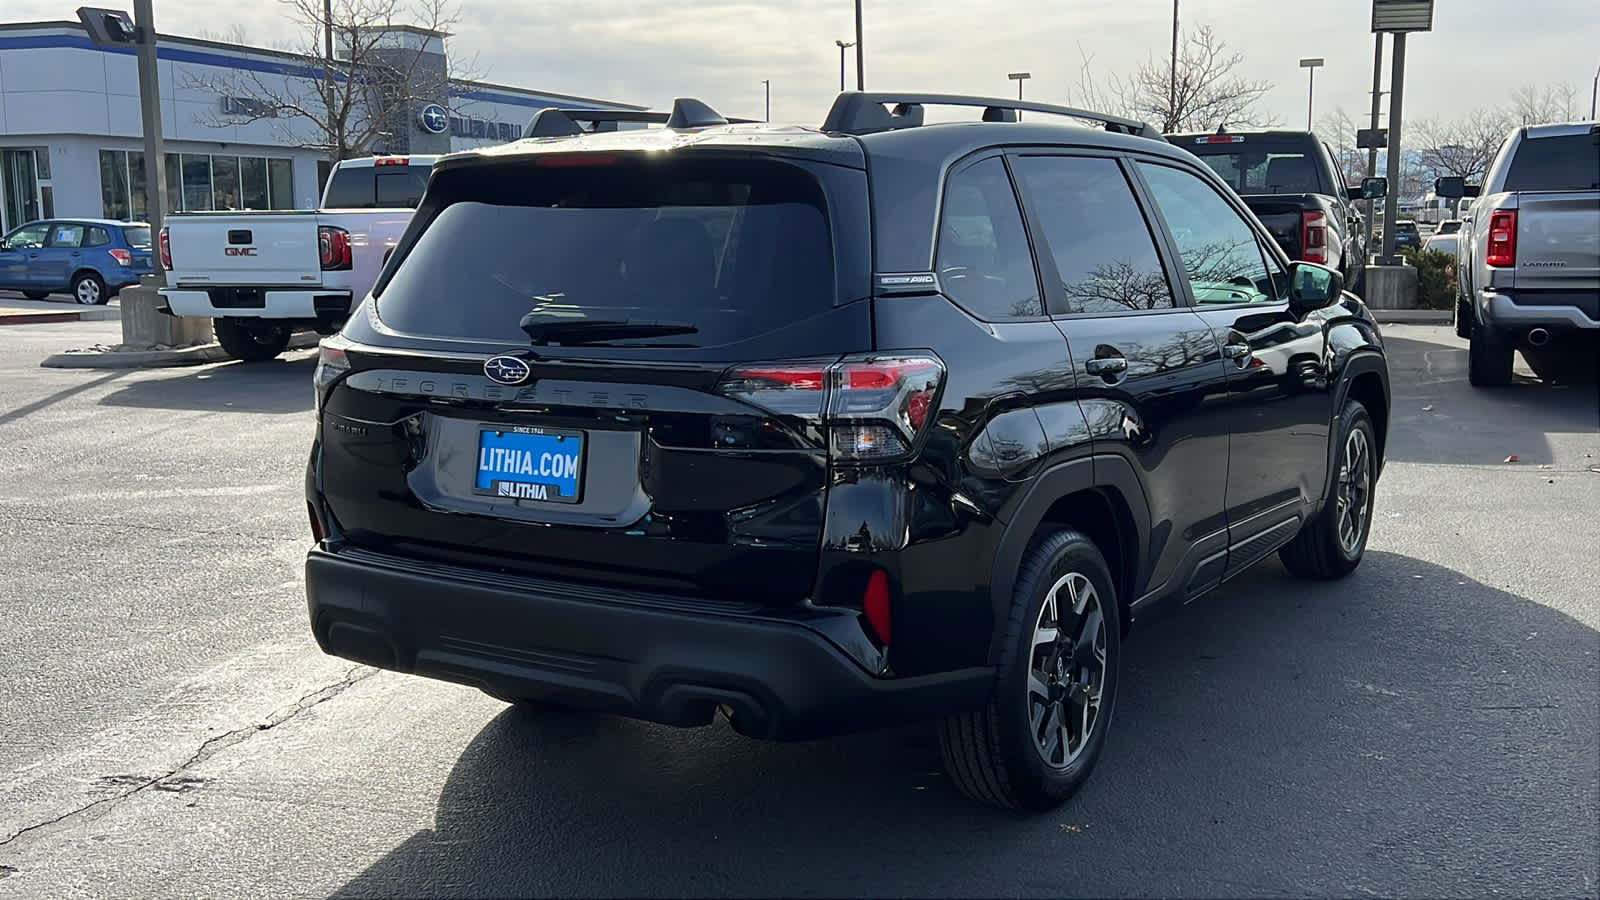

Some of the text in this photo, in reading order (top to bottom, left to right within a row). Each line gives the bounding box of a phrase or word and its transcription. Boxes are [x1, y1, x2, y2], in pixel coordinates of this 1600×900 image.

[224, 247, 258, 257] GMC
[513, 426, 530, 434] SINCE
[479, 447, 578, 479] LITHIA.COM
[509, 482, 548, 500] LITHIA
